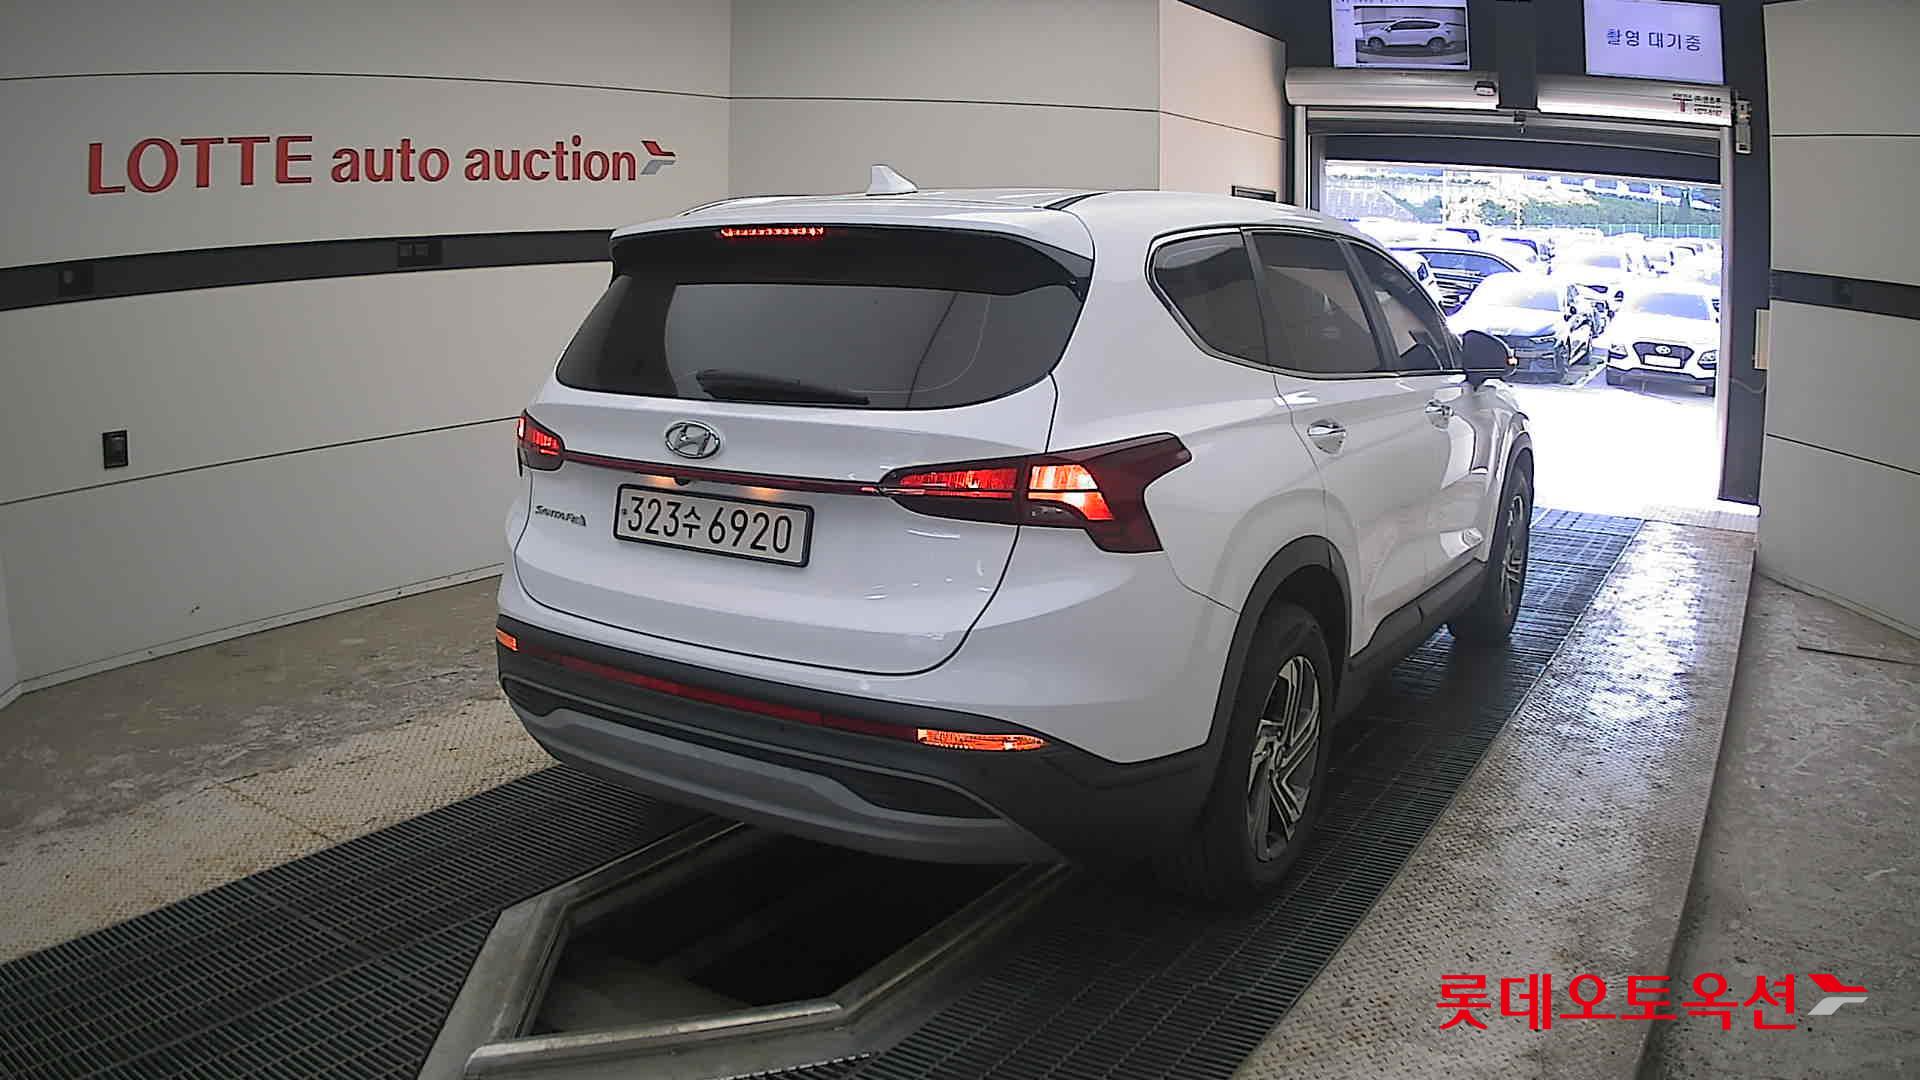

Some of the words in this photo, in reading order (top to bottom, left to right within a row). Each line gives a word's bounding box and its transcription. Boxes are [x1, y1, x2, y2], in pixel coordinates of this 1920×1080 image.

[1648, 32, 1701, 51] 대기중
[88, 136, 313, 195] LOTTE
[331, 138, 452, 182] auto
[465, 135, 637, 182] auction
[628, 496, 792, 554] 323수6920
